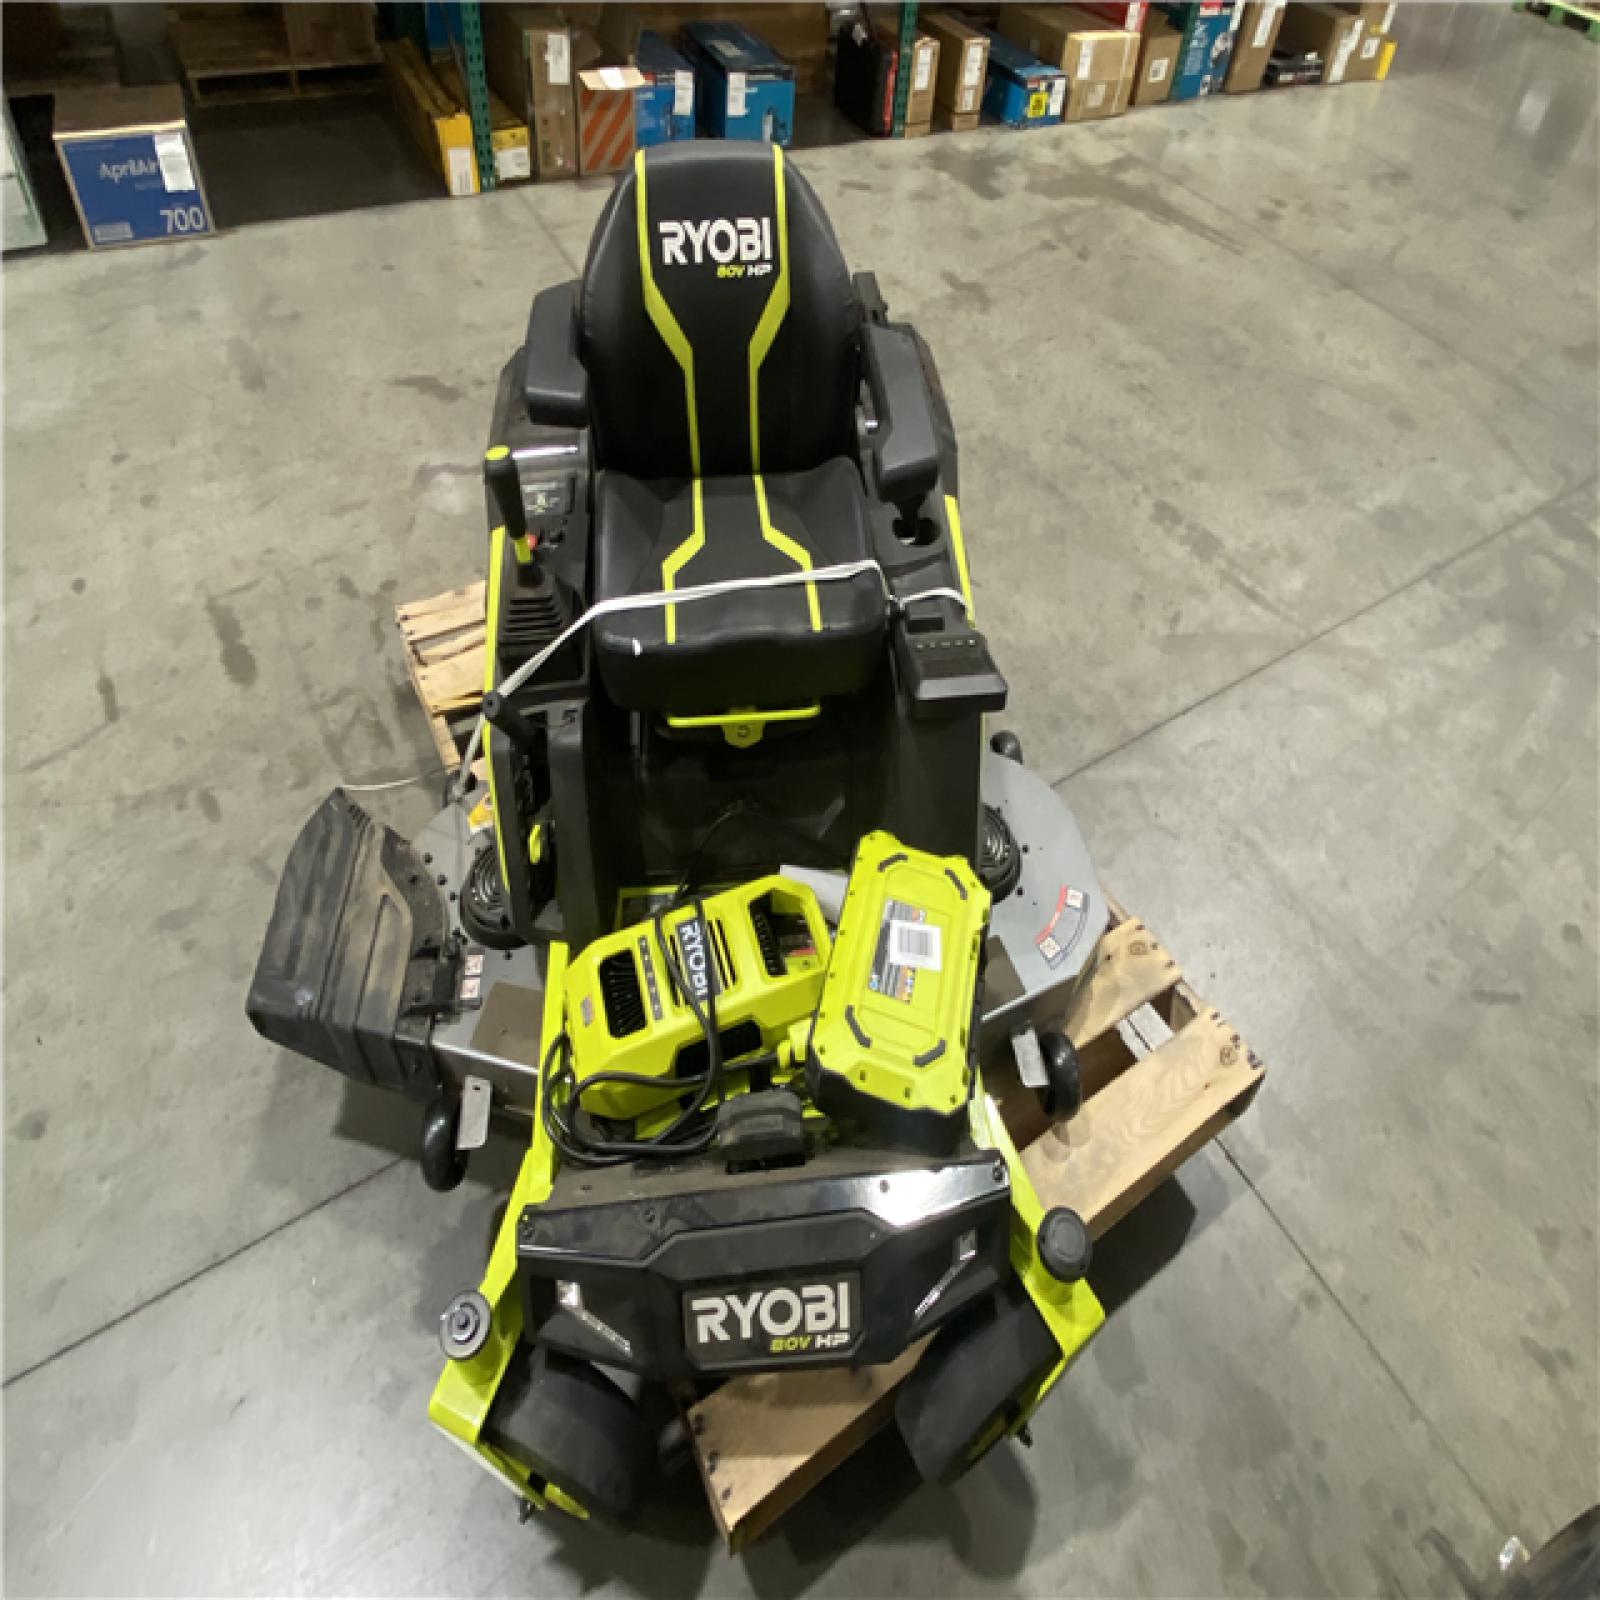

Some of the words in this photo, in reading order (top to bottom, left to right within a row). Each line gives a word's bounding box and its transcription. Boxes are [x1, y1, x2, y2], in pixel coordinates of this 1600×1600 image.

[160, 207, 203, 233] 700
[658, 217, 772, 265] RYOBI
[680, 920, 709, 996] RYOBI
[691, 1281, 851, 1344] RYOBI
[770, 1336, 812, 1352] 80V
[814, 1333, 850, 1349] HP
